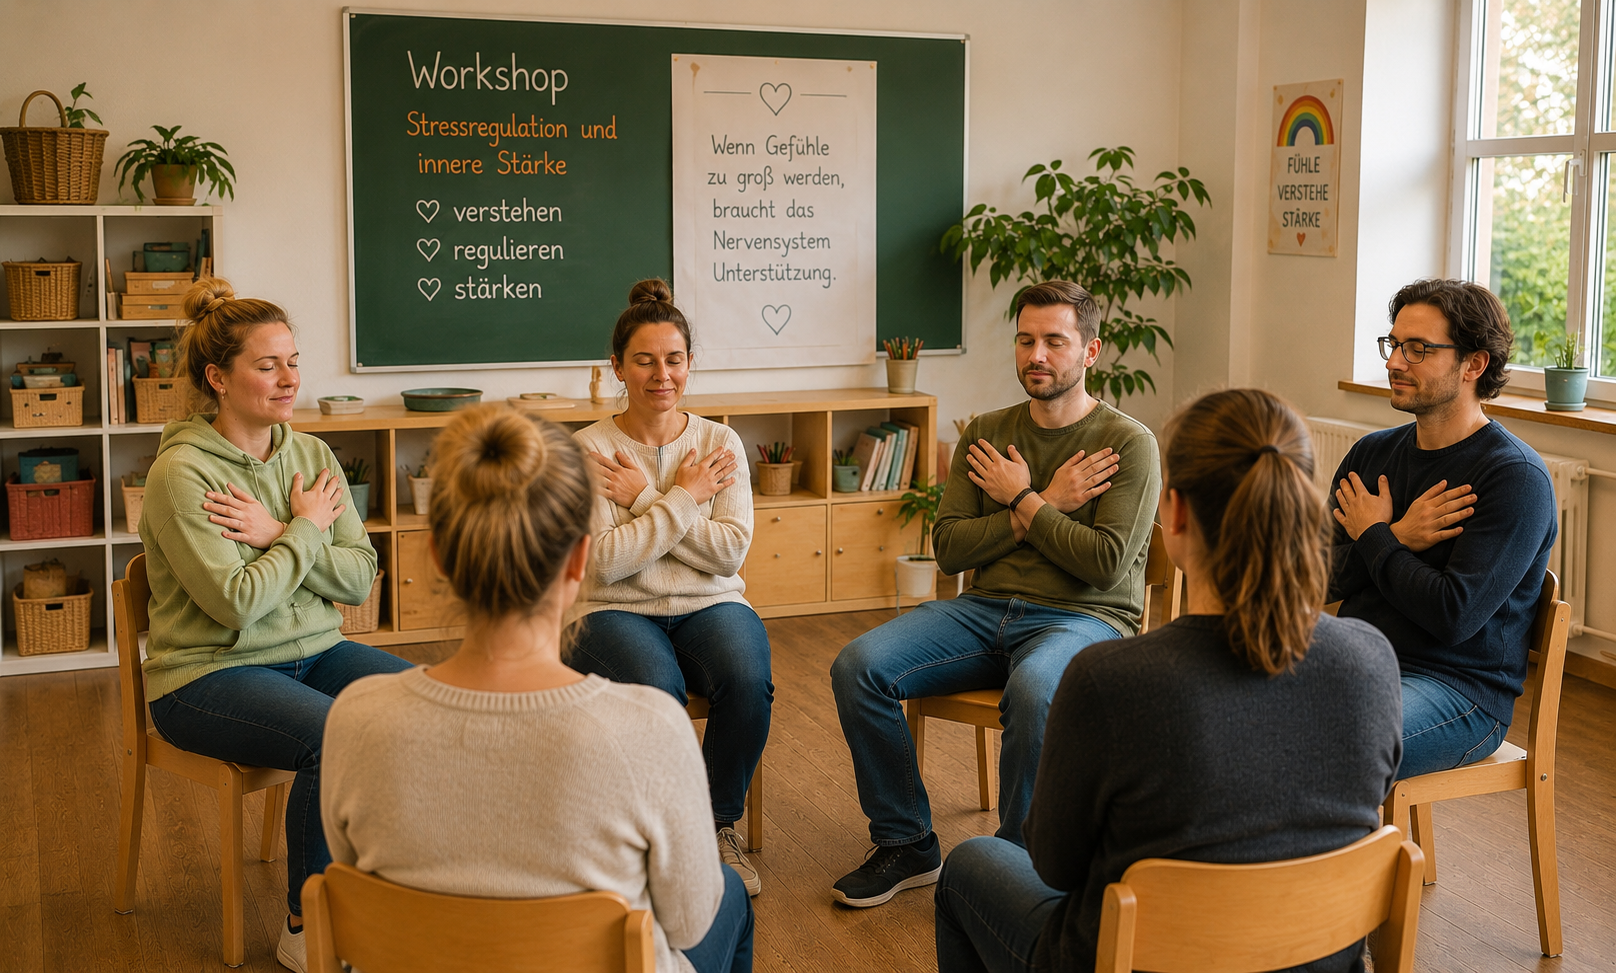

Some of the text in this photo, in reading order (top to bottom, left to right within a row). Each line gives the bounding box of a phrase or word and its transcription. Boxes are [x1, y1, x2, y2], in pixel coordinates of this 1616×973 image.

[408, 51, 568, 105] Workshop
[407, 111, 617, 147] Stressregulation und
[712, 135, 829, 162] Wenn Gefühle
[419, 150, 566, 175] innere Stärke
[1288, 154, 1320, 173] FÜHLE
[708, 166, 844, 193] zu groß werden,
[1278, 184, 1328, 201] VERSTEHE
[454, 198, 561, 222] verstehen
[714, 198, 814, 218] braucht das
[1282, 208, 1320, 228] STÄRKE
[455, 236, 563, 269] regulieren
[714, 230, 830, 257] Nervensystem
[455, 274, 541, 299] stärken
[714, 262, 836, 289] Unterstützung.
